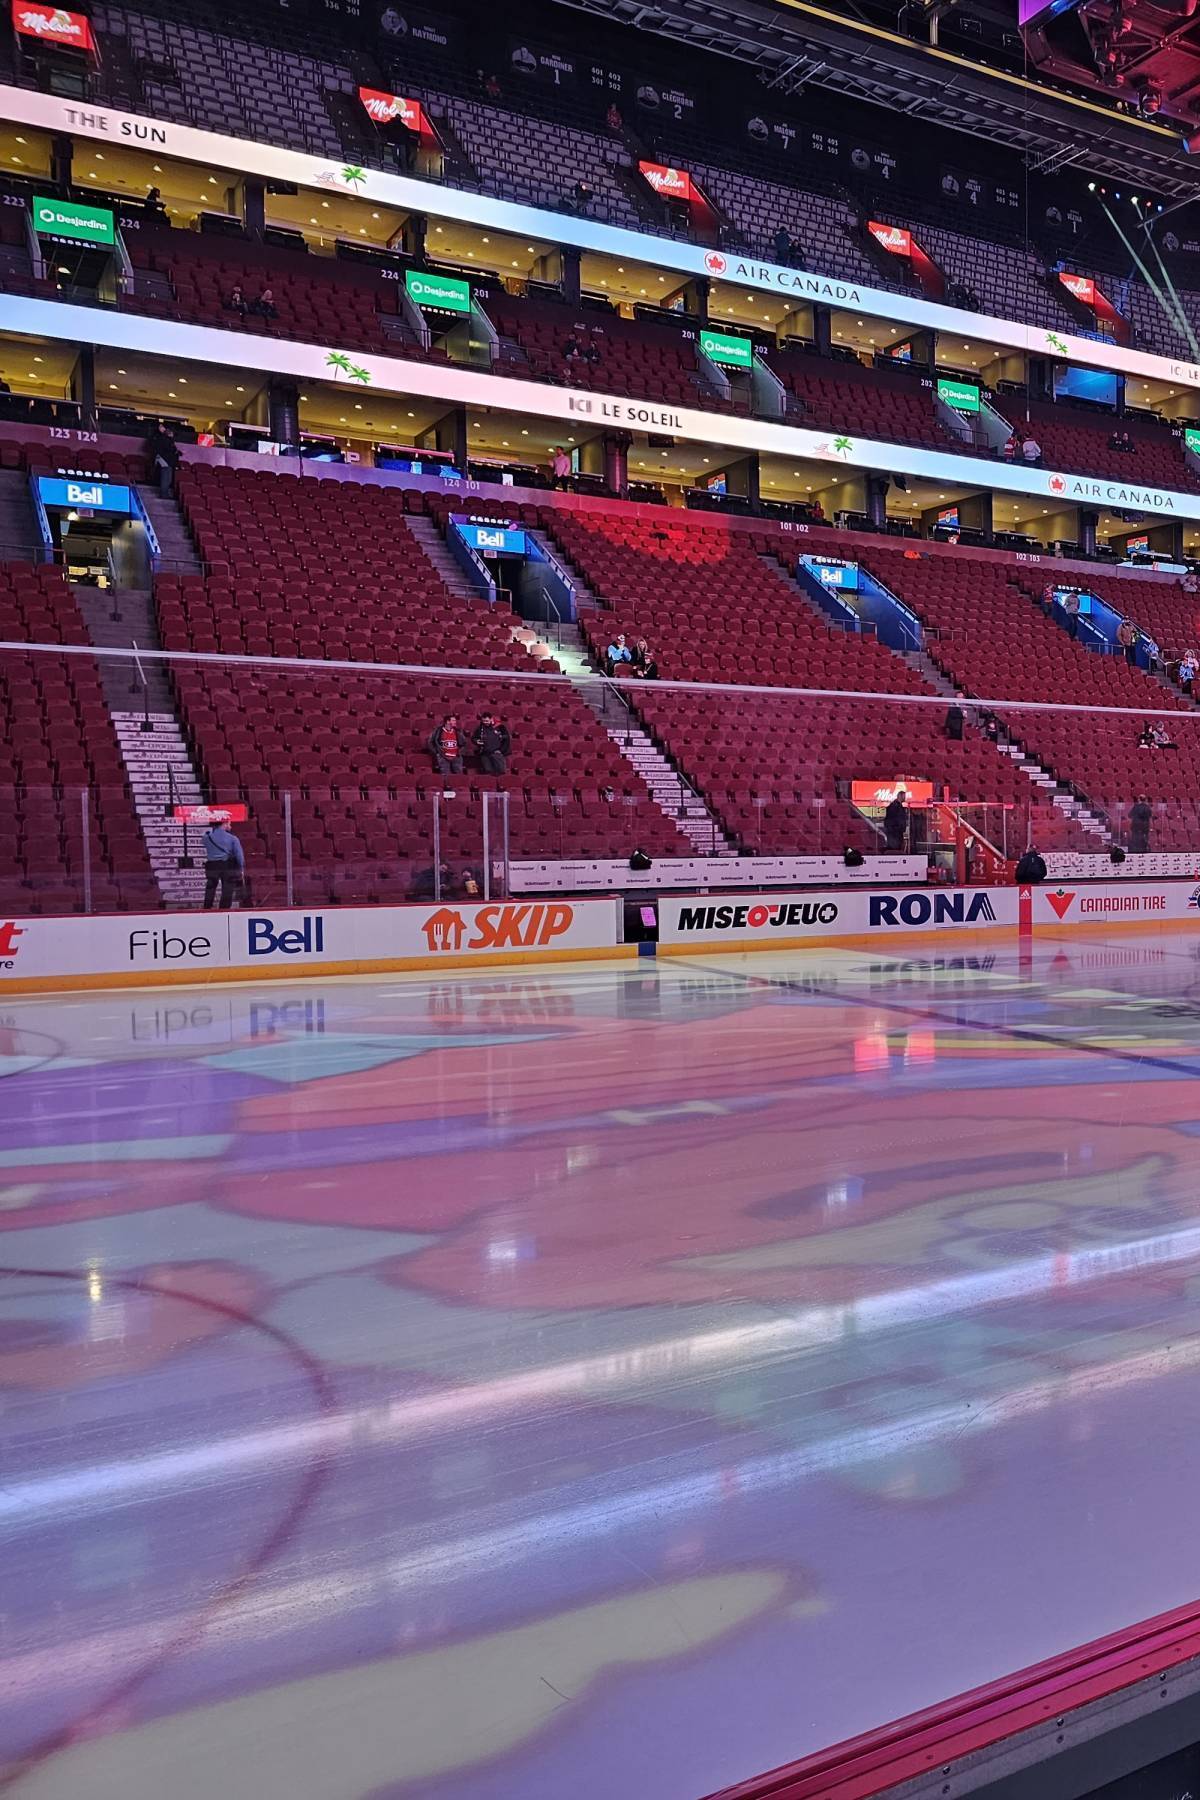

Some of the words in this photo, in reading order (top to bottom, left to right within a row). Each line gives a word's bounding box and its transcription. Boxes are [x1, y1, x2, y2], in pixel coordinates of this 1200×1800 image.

[18, 11, 82, 36] Molson
[412, 28, 448, 46] RAYMOND
[540, 56, 574, 73] GARDINER
[554, 69, 561, 85] 1
[608, 71, 622, 82] 402
[608, 80, 622, 92] 302
[674, 104, 682, 120] 2
[65, 108, 108, 131] THE
[120, 121, 168, 145] SUN
[783, 136, 790, 150] 7
[645, 168, 686, 188] Molson
[881, 166, 890, 180] 4
[3, 195, 26, 208] 223
[970, 191, 977, 206] 4
[55, 211, 108, 233] Desjardins
[120, 216, 142, 231] 224
[871, 230, 906, 247] Molson
[381, 269, 400, 282] 224
[735, 262, 770, 284] AIR
[776, 268, 861, 303] CANADA
[422, 284, 466, 302] Desjardins
[473, 287, 490, 299] 201
[682, 329, 697, 340] 201
[714, 342, 748, 359] Desjardins
[753, 344, 769, 355] 202
[1188, 368, 1200, 380] LE
[921, 379, 933, 389] 202
[947, 388, 977, 402] Desjardins
[980, 390, 992, 400] 203
[568, 396, 592, 414] ICI
[602, 401, 622, 418] LE
[627, 406, 683, 429] SOLEIL
[49, 426, 71, 440] 123
[77, 429, 98, 443] 124
[444, 477, 460, 489] 124
[466, 479, 481, 491] 101
[67, 484, 103, 505] Bell
[1072, 481, 1102, 497] AIR
[1107, 486, 1174, 509] CANADA
[780, 520, 792, 531] 101
[796, 523, 809, 534] 102
[476, 529, 505, 548] Bell
[1015, 552, 1027, 561] 102
[1029, 553, 1040, 562] 103
[820, 568, 841, 584] Bell
[868, 893, 998, 927] RONA
[1080, 896, 1140, 913] CANADIAN
[1142, 895, 1166, 911] TIRE
[467, 904, 574, 950] SKIP
[247, 916, 324, 956] Bell
[129, 930, 212, 965] Fibe
